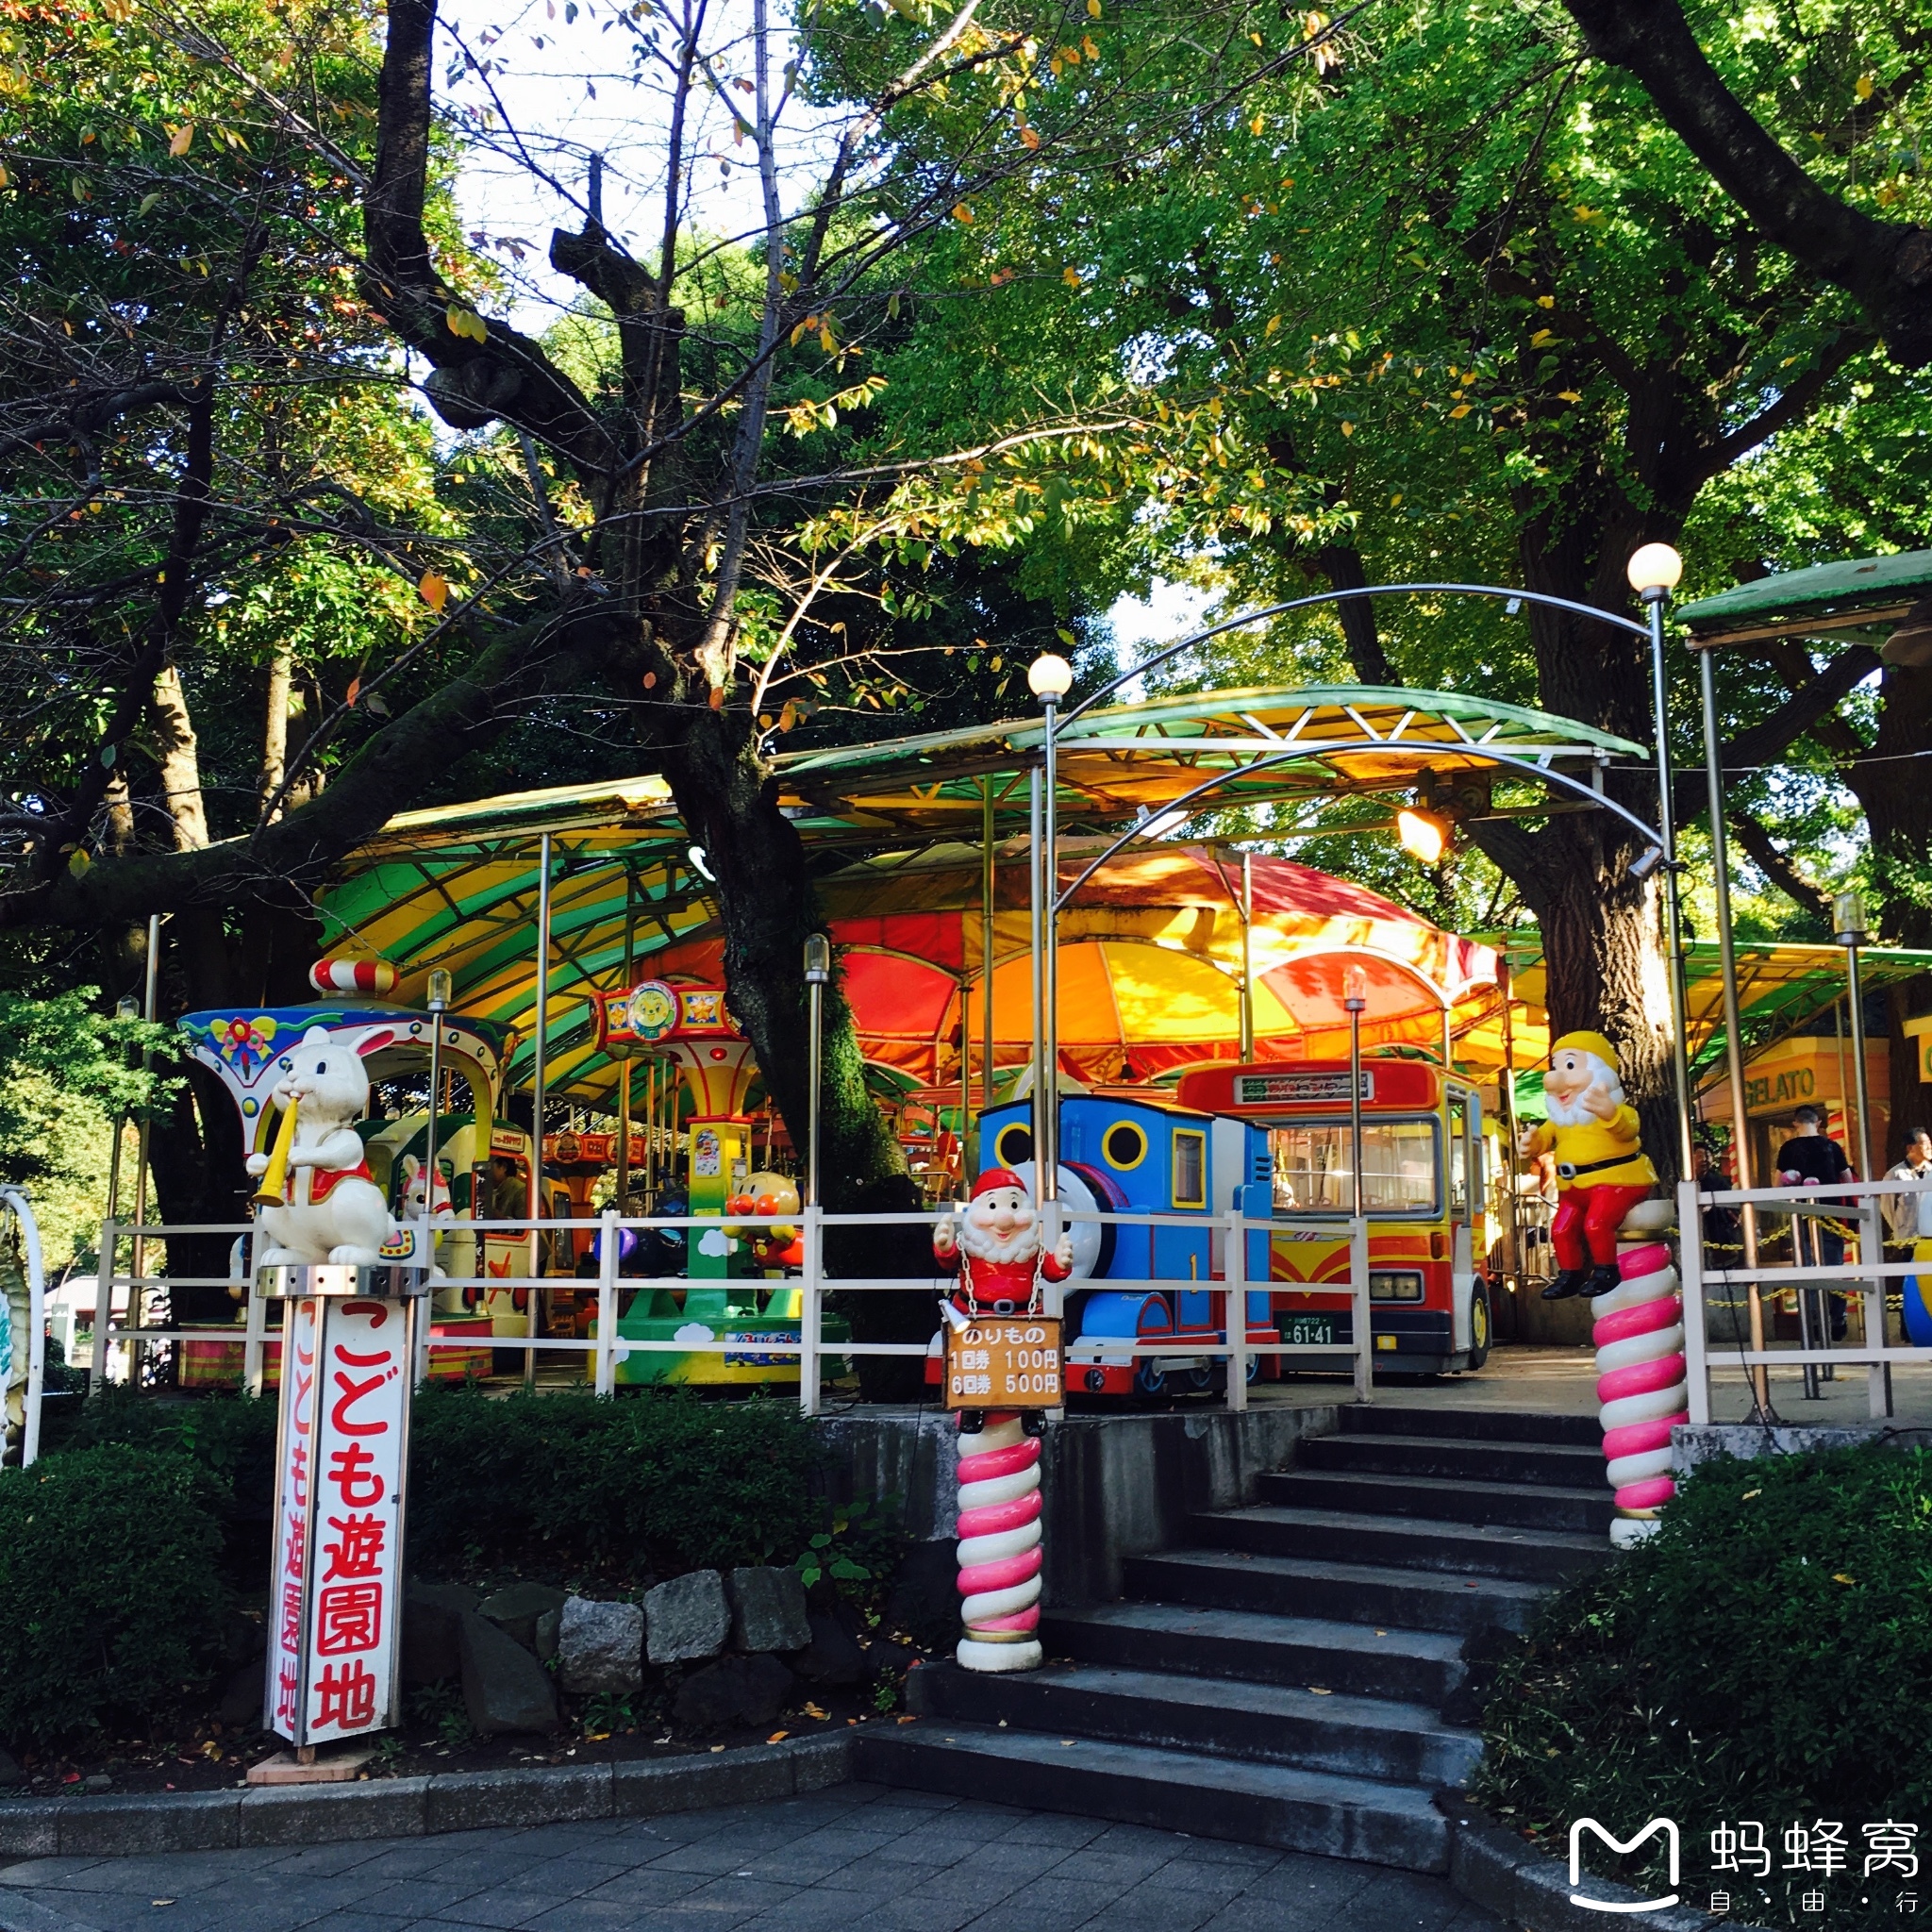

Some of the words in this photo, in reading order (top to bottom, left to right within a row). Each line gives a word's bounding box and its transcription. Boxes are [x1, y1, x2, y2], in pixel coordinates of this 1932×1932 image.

[1743, 1067, 1815, 1108] GELATO
[962, 1326, 1046, 1345] のりもの
[950, 1349, 991, 1370] 1回券
[1005, 1349, 1058, 1370] 100円
[951, 1374, 991, 1394] 6回券
[1006, 1374, 1058, 1393] 500円
[311, 1301, 398, 1731] こども遊園地
